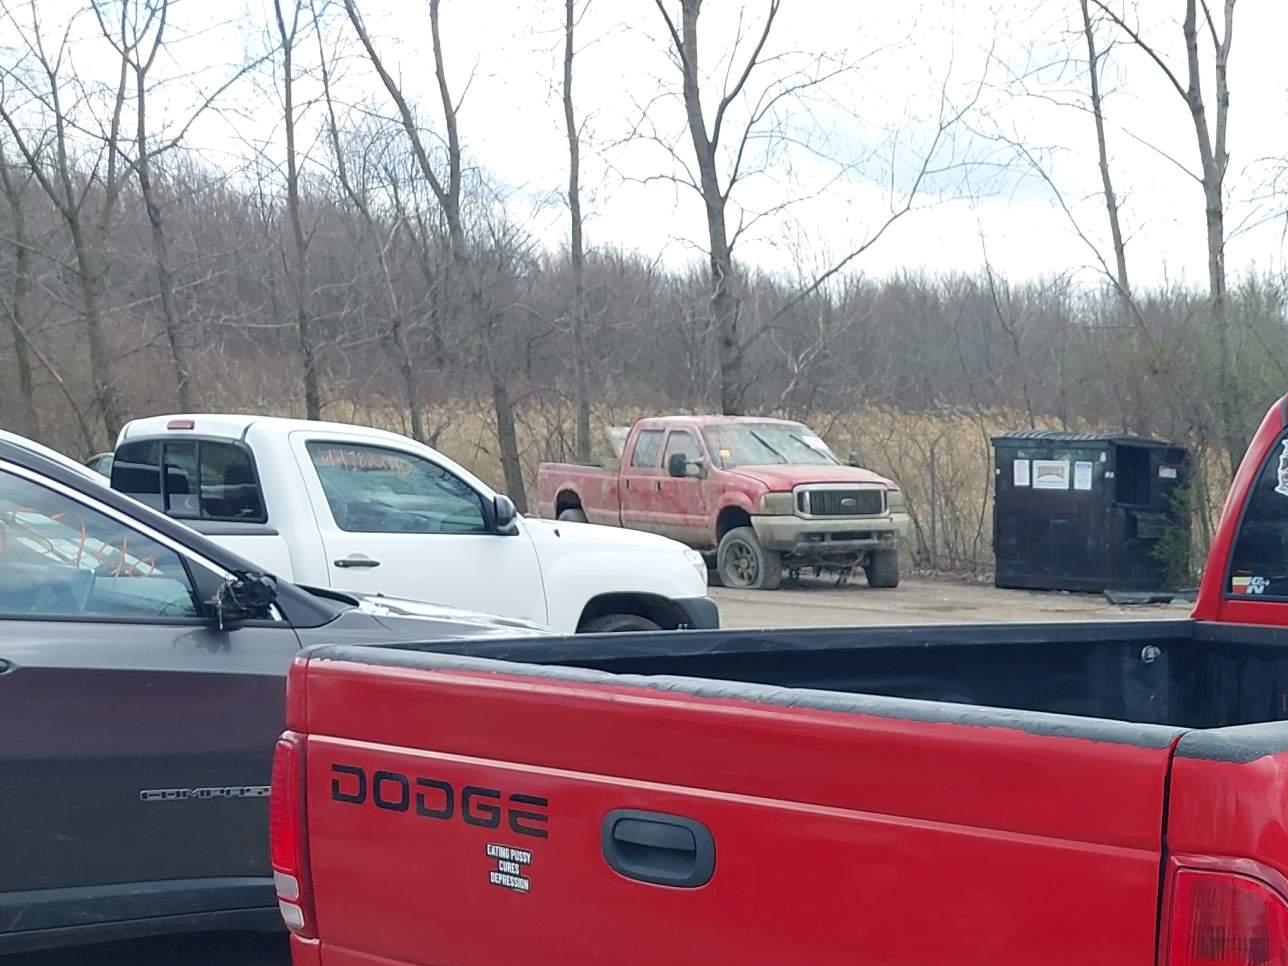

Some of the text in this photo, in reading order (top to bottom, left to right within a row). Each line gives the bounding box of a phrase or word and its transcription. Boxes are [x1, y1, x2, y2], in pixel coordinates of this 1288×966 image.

[331, 764, 548, 839] DODGE
[487, 844, 531, 864] EATING PUSSY
[499, 860, 519, 874] CURES
[490, 871, 529, 890] DEPRESSION
